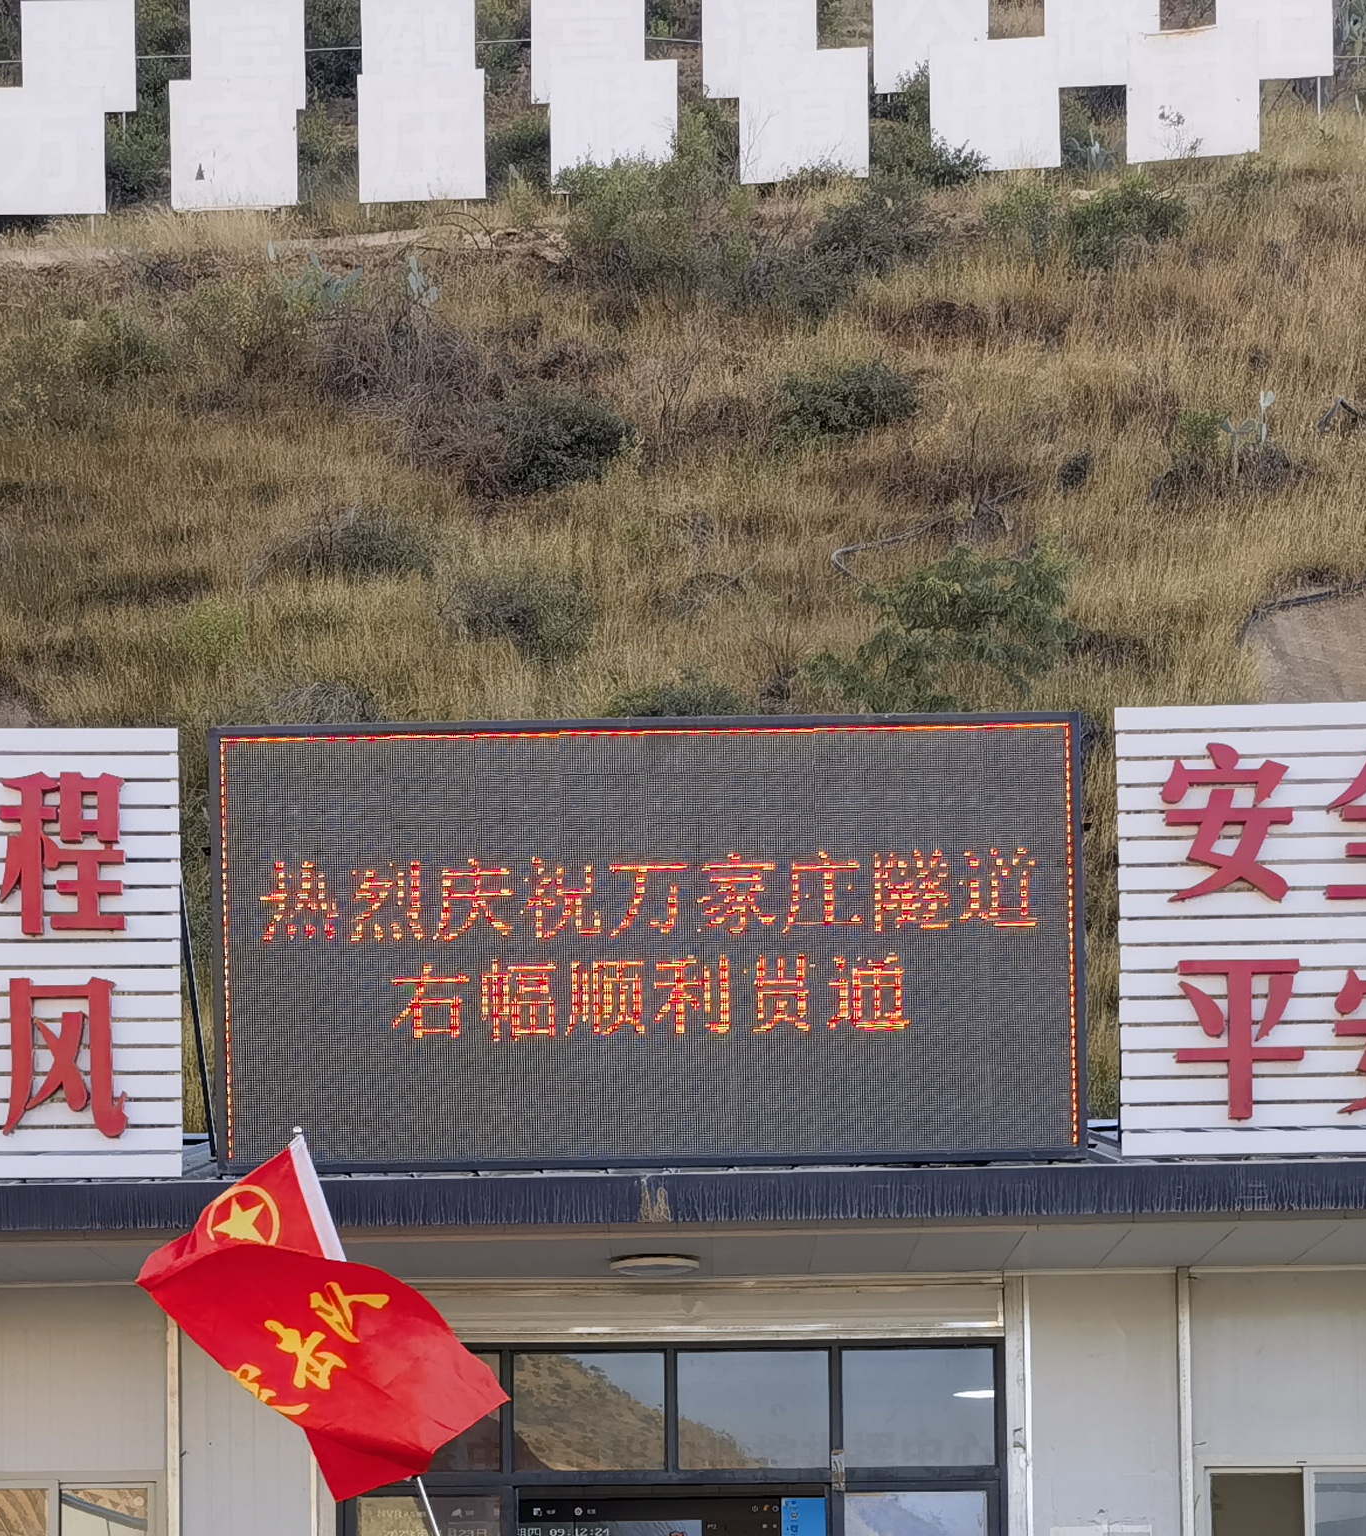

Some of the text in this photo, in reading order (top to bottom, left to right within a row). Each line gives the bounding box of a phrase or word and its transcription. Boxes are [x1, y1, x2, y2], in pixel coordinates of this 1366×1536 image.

[259, 848, 1037, 943] 热烈庆祝万家庄隧道
[392, 951, 911, 1043] 右幅顺利贯通
[549, 1527, 610, 1536] 09:12:24
